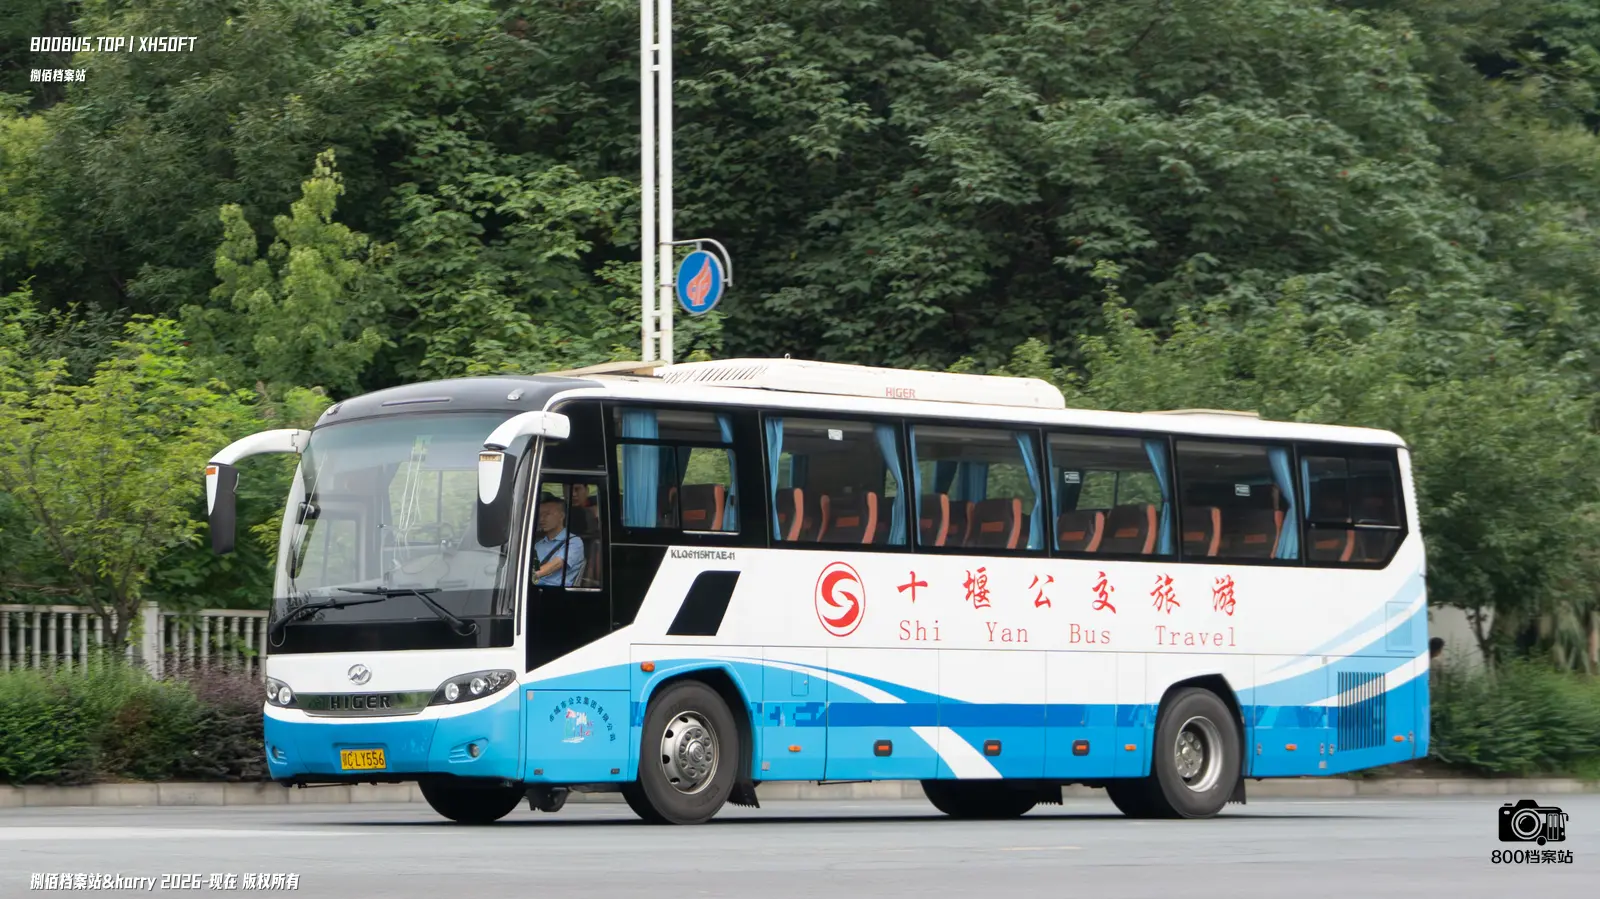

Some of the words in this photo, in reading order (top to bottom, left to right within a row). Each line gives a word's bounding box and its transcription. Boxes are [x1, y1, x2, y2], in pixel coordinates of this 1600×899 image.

[885, 386, 916, 398] HIGER
[896, 567, 1237, 616] 十堰公交旅游
[899, 619, 941, 641] Shi
[985, 621, 1029, 643] Yan
[1069, 623, 1111, 644] Bus
[1155, 625, 1236, 647] Travel
[329, 695, 391, 710] HIGER
